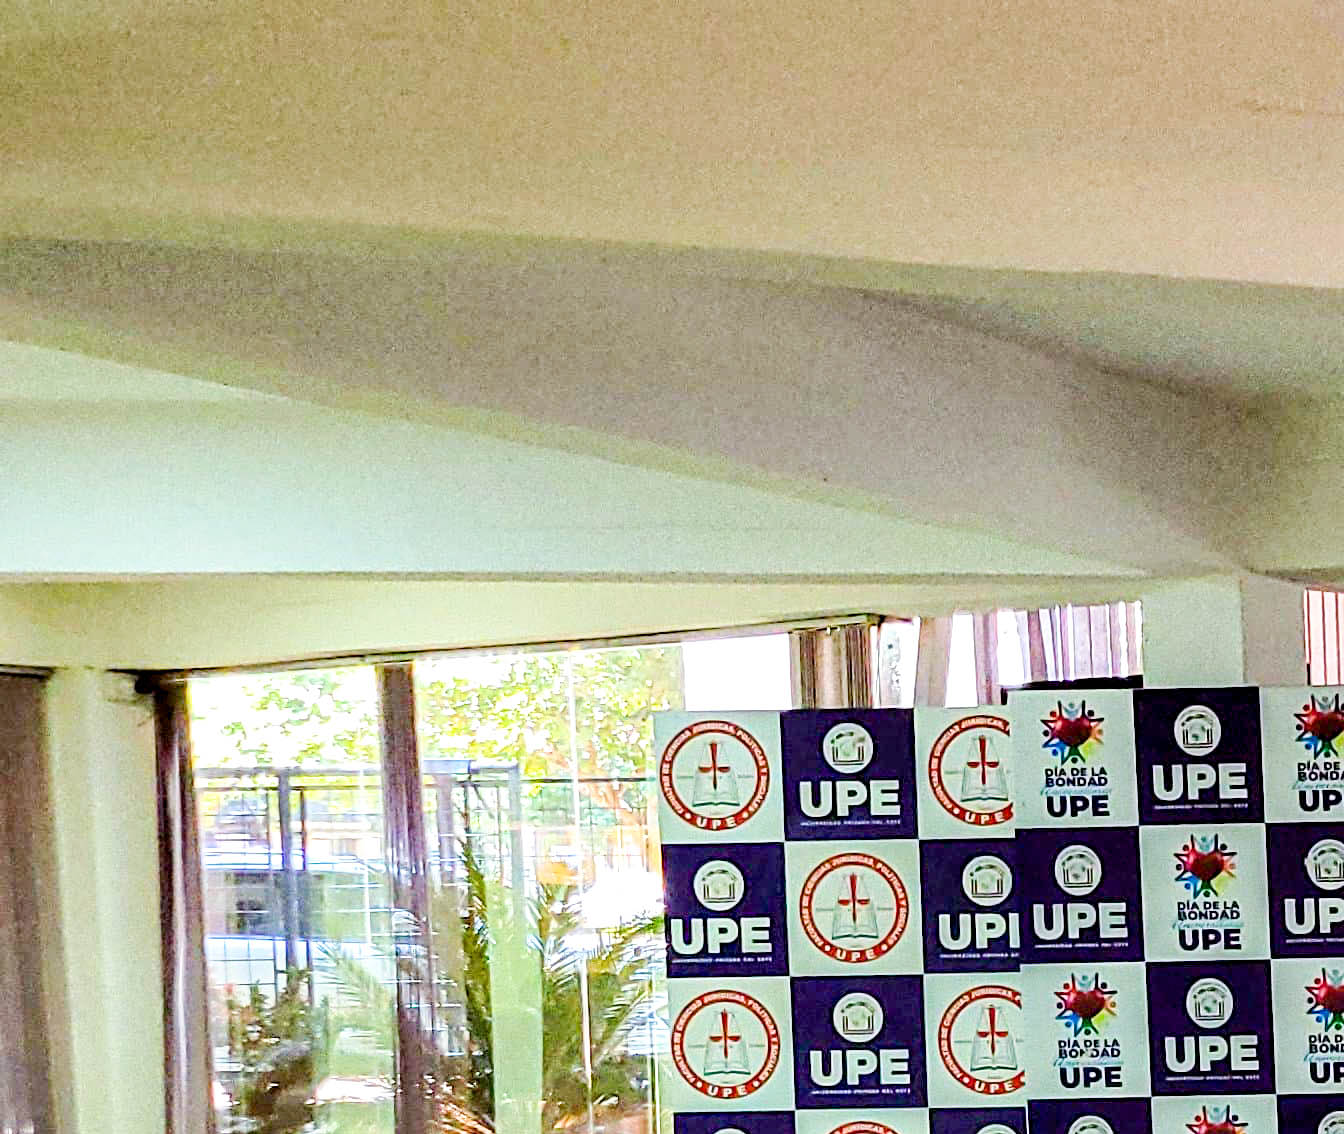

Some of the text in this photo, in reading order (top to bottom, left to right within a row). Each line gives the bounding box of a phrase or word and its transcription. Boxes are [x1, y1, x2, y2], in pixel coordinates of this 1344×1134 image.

[1071, 768, 1087, 777] DE
[1091, 767, 1107, 776] LA
[1324, 761, 1340, 771] DE
[1045, 776, 1107, 787] BONDAD
[1152, 763, 1249, 801] UPE
[799, 780, 900, 817] UPE
[1047, 795, 1110, 817] UPE
[696, 817, 736, 829] UPE
[964, 813, 1005, 825] UPE
[1203, 902, 1219, 910] DE
[1224, 901, 1239, 910] LA
[1033, 902, 1128, 941] UPE
[671, 917, 772, 955] UPE
[1178, 929, 1242, 950] UPE
[835, 949, 875, 962] UPE
[1084, 1039, 1100, 1048] DE
[1104, 1038, 1120, 1047] LA
[1164, 1035, 1259, 1073] UPE
[809, 1049, 910, 1087] UPE
[1060, 1067, 1123, 1088] UPE
[707, 1087, 747, 1098] UPE
[975, 1081, 1014, 1093] UPE
